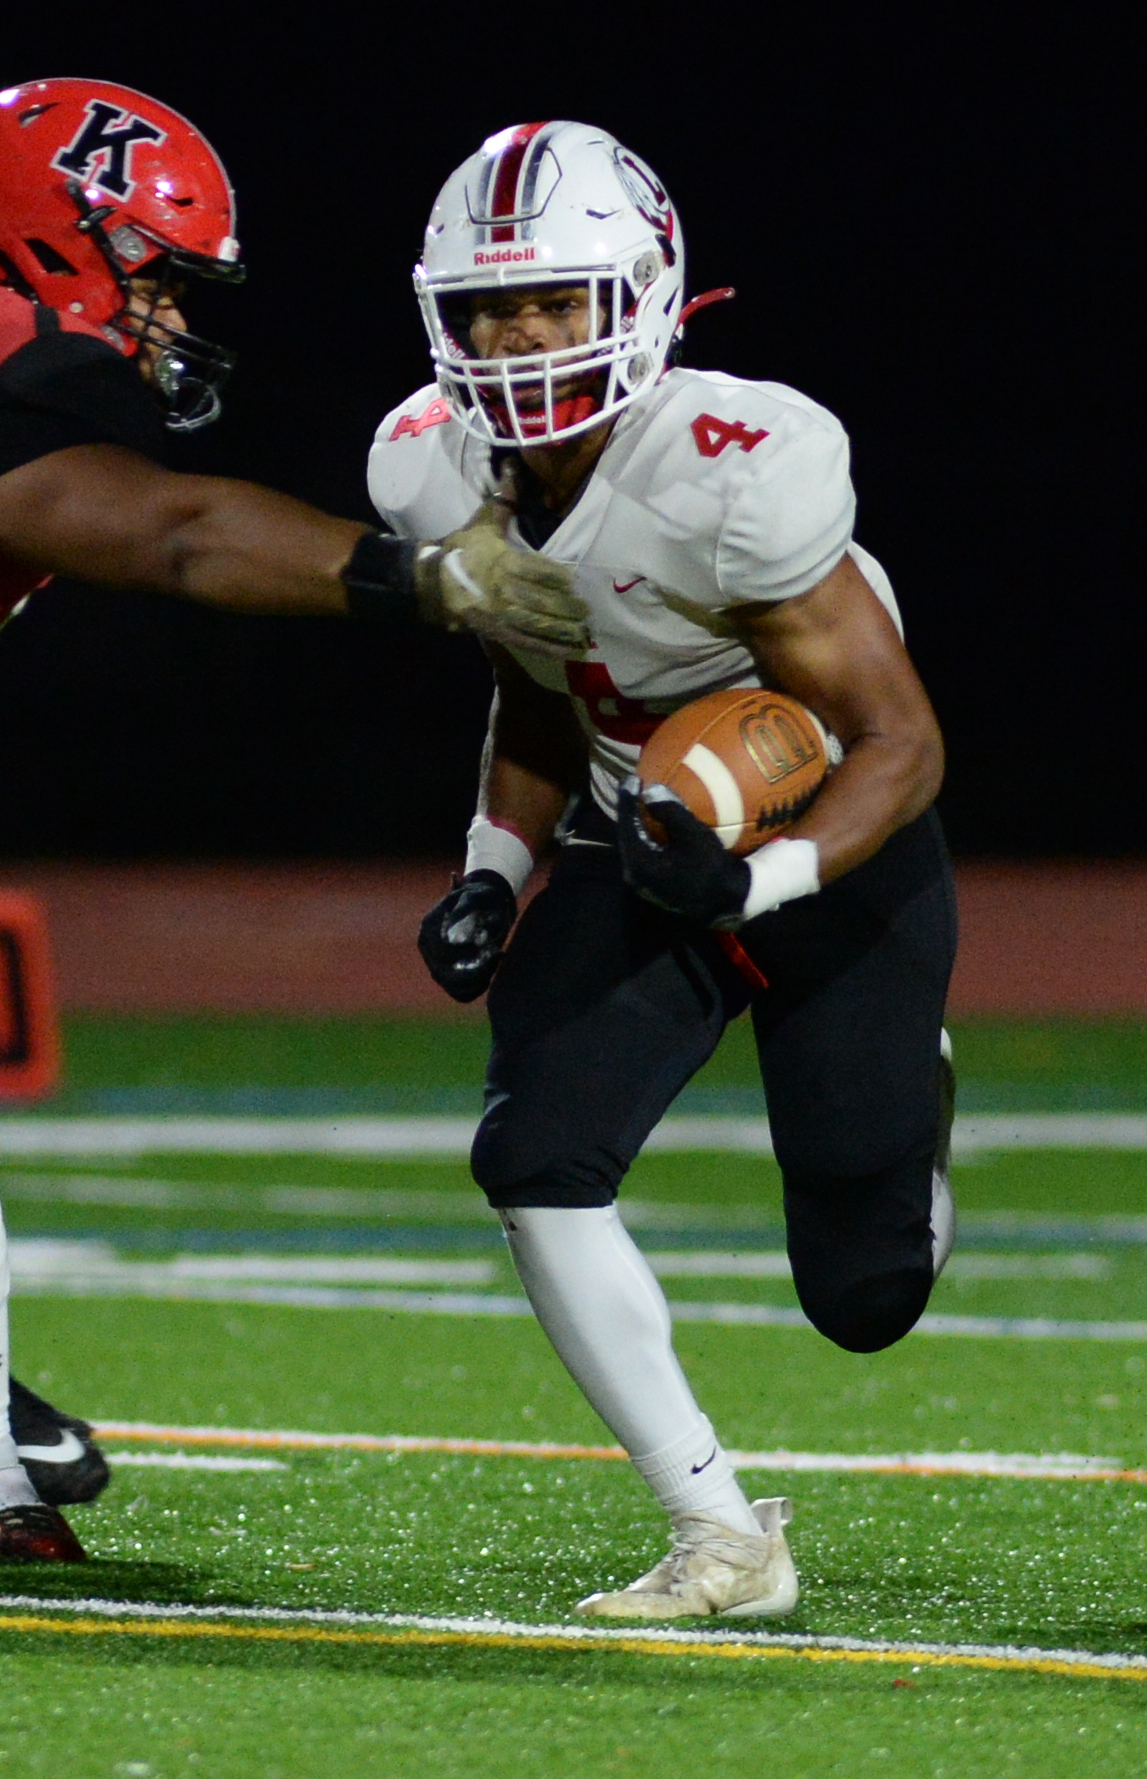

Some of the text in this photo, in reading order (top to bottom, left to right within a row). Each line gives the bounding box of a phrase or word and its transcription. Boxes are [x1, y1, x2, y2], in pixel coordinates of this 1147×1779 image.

[50, 98, 168, 202] K
[474, 248, 535, 266] Riddell
[689, 413, 770, 458] 4
